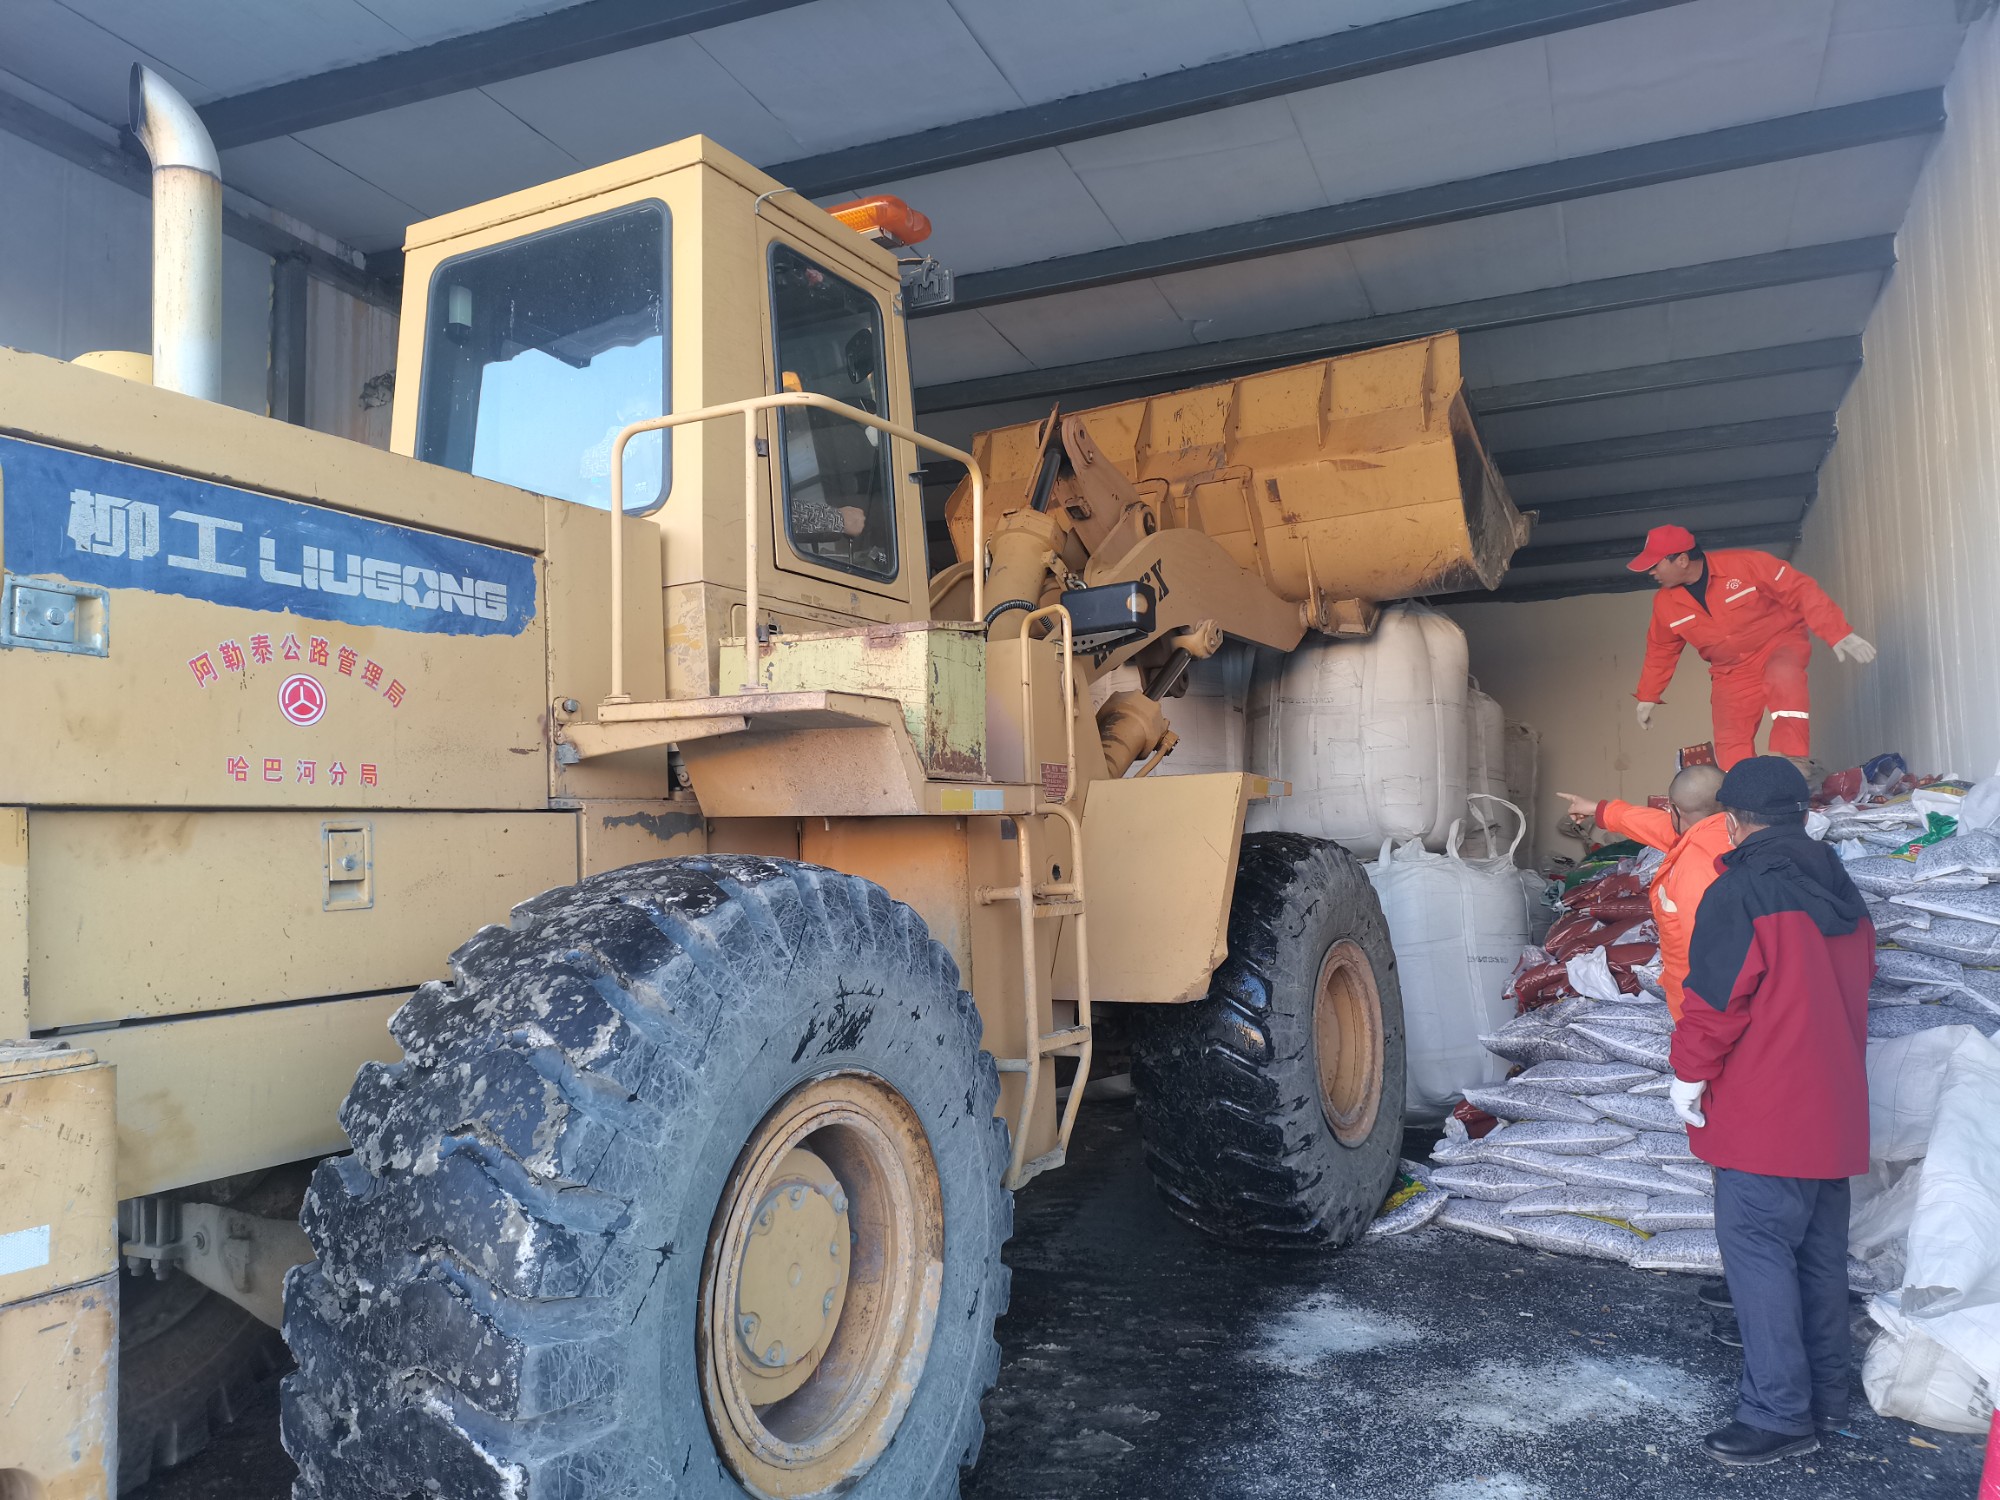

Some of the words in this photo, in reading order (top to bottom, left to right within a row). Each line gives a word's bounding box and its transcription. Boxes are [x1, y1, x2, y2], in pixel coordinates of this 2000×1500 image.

[67, 489, 247, 577] 柳工
[260, 536, 508, 622] LIUGONG
[188, 633, 407, 708] 阿勒泰公路管理局
[226, 756, 378, 787] 哈巴河分局
